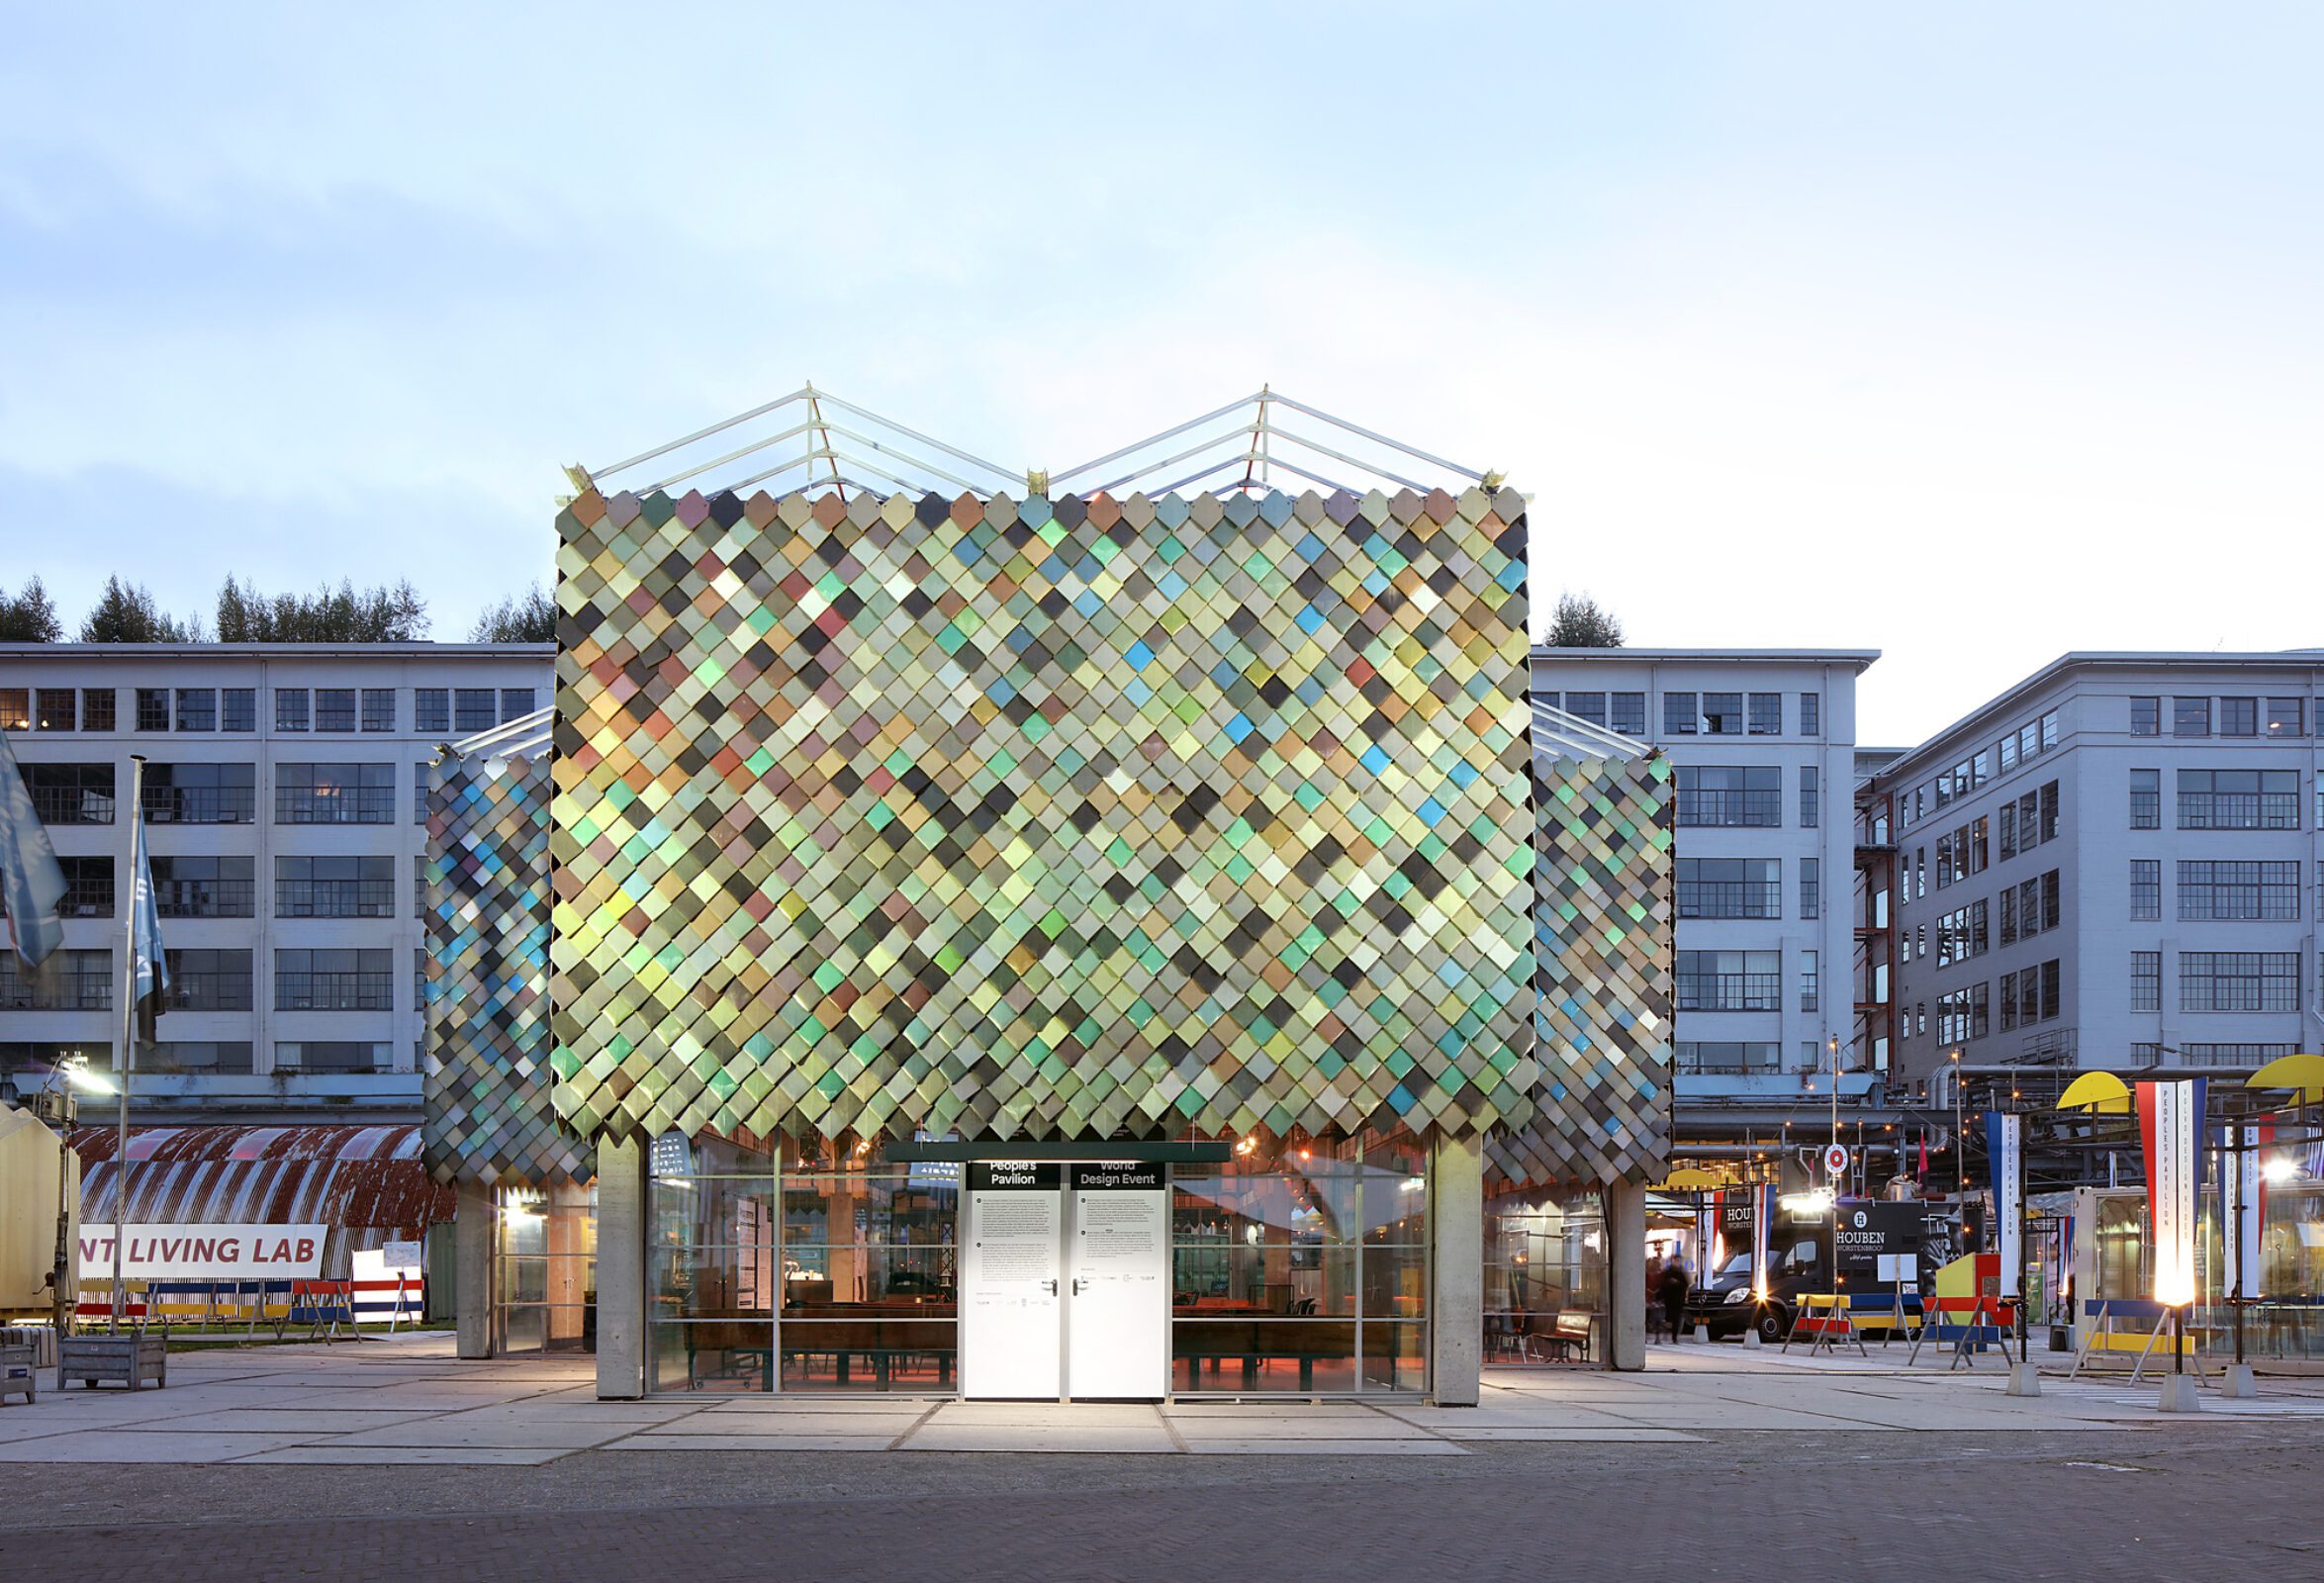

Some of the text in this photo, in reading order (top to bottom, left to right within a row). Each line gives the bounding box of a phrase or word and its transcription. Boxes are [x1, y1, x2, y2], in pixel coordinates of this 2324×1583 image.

[990, 1163, 1037, 1172] People's
[991, 1172, 1036, 1184] Pavilion
[1080, 1172, 1156, 1186] Design Event
[1836, 1232, 1886, 1244] HOUBEN
[129, 1238, 240, 1262] LIVING
[252, 1238, 315, 1262] LAB
